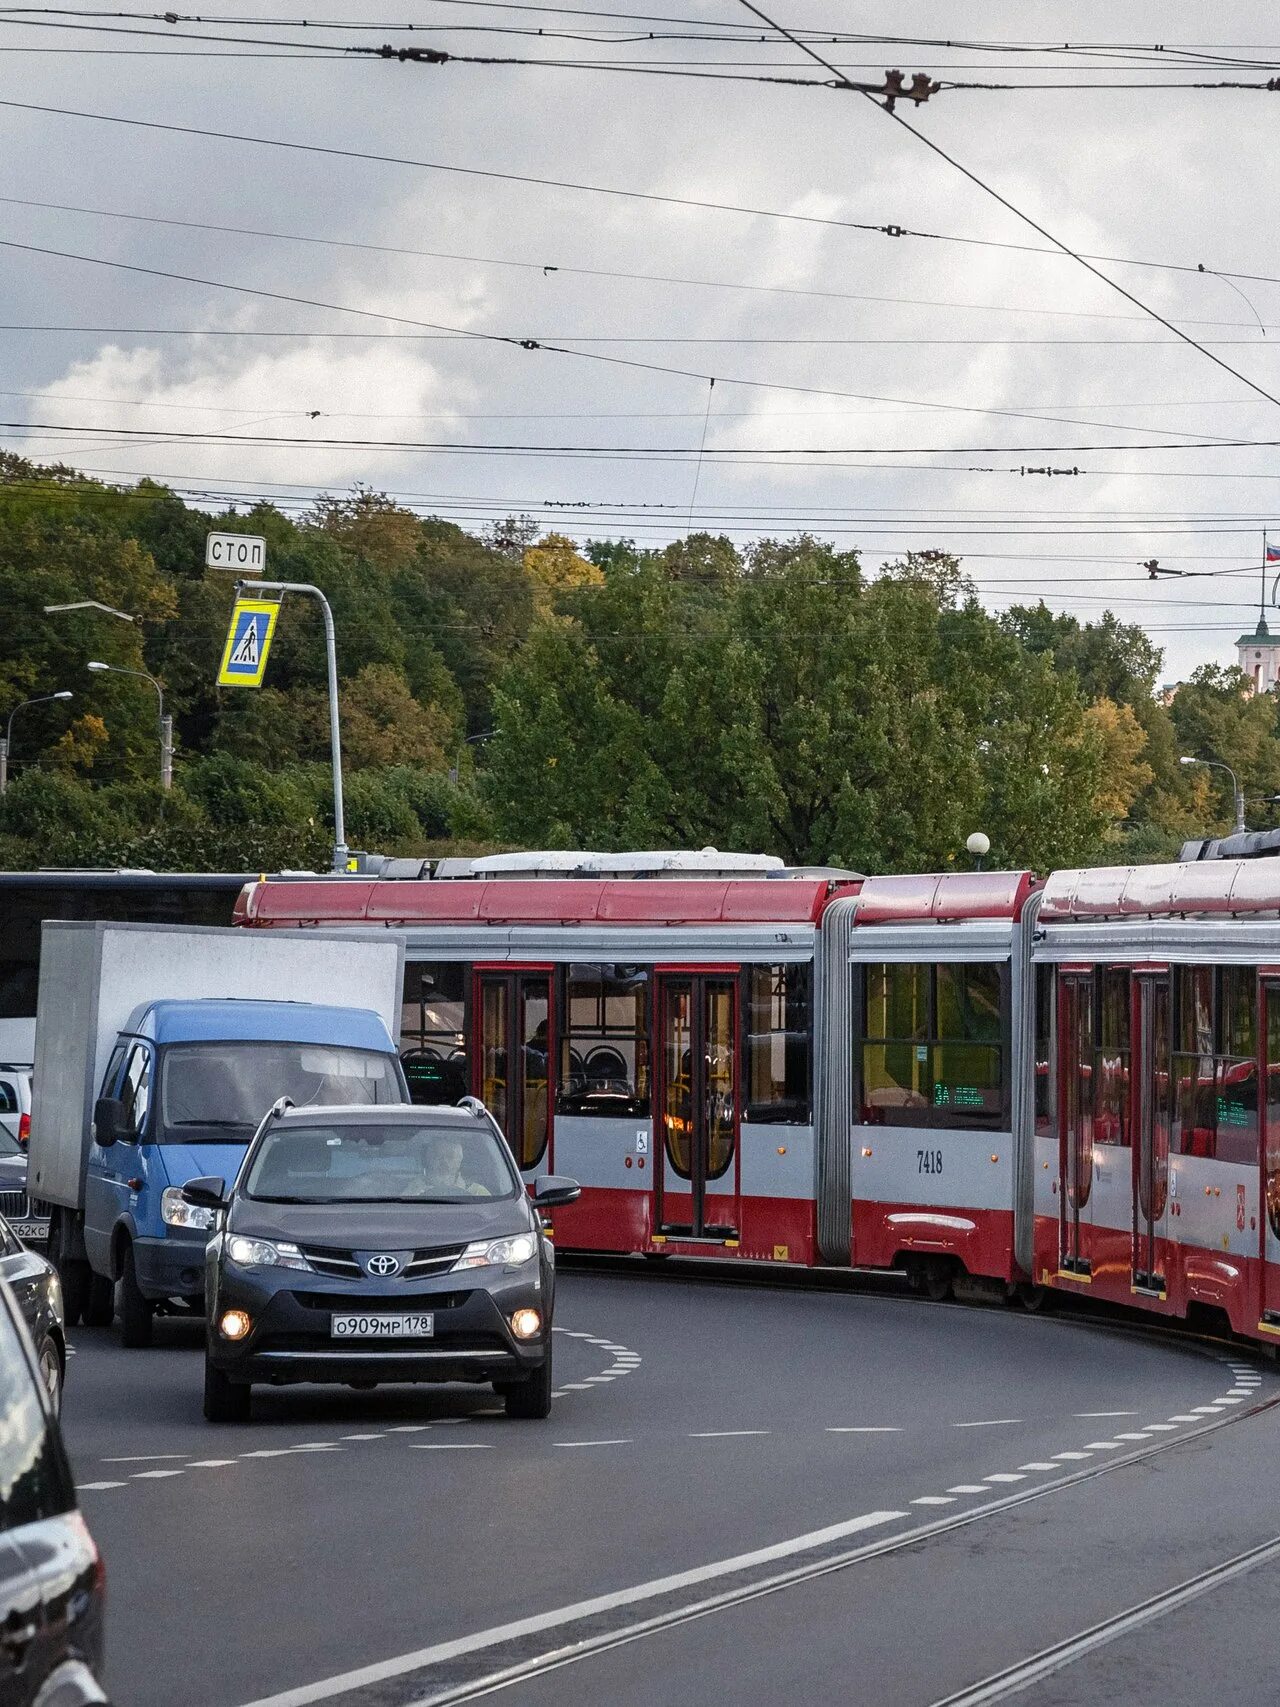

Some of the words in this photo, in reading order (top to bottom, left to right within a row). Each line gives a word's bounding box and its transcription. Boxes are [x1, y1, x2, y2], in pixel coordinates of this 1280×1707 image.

[212, 541, 261, 564] СТОП
[917, 1150, 943, 1174] 7418
[336, 1318, 401, 1334] О909МР
[404, 1317, 428, 1330] 178
